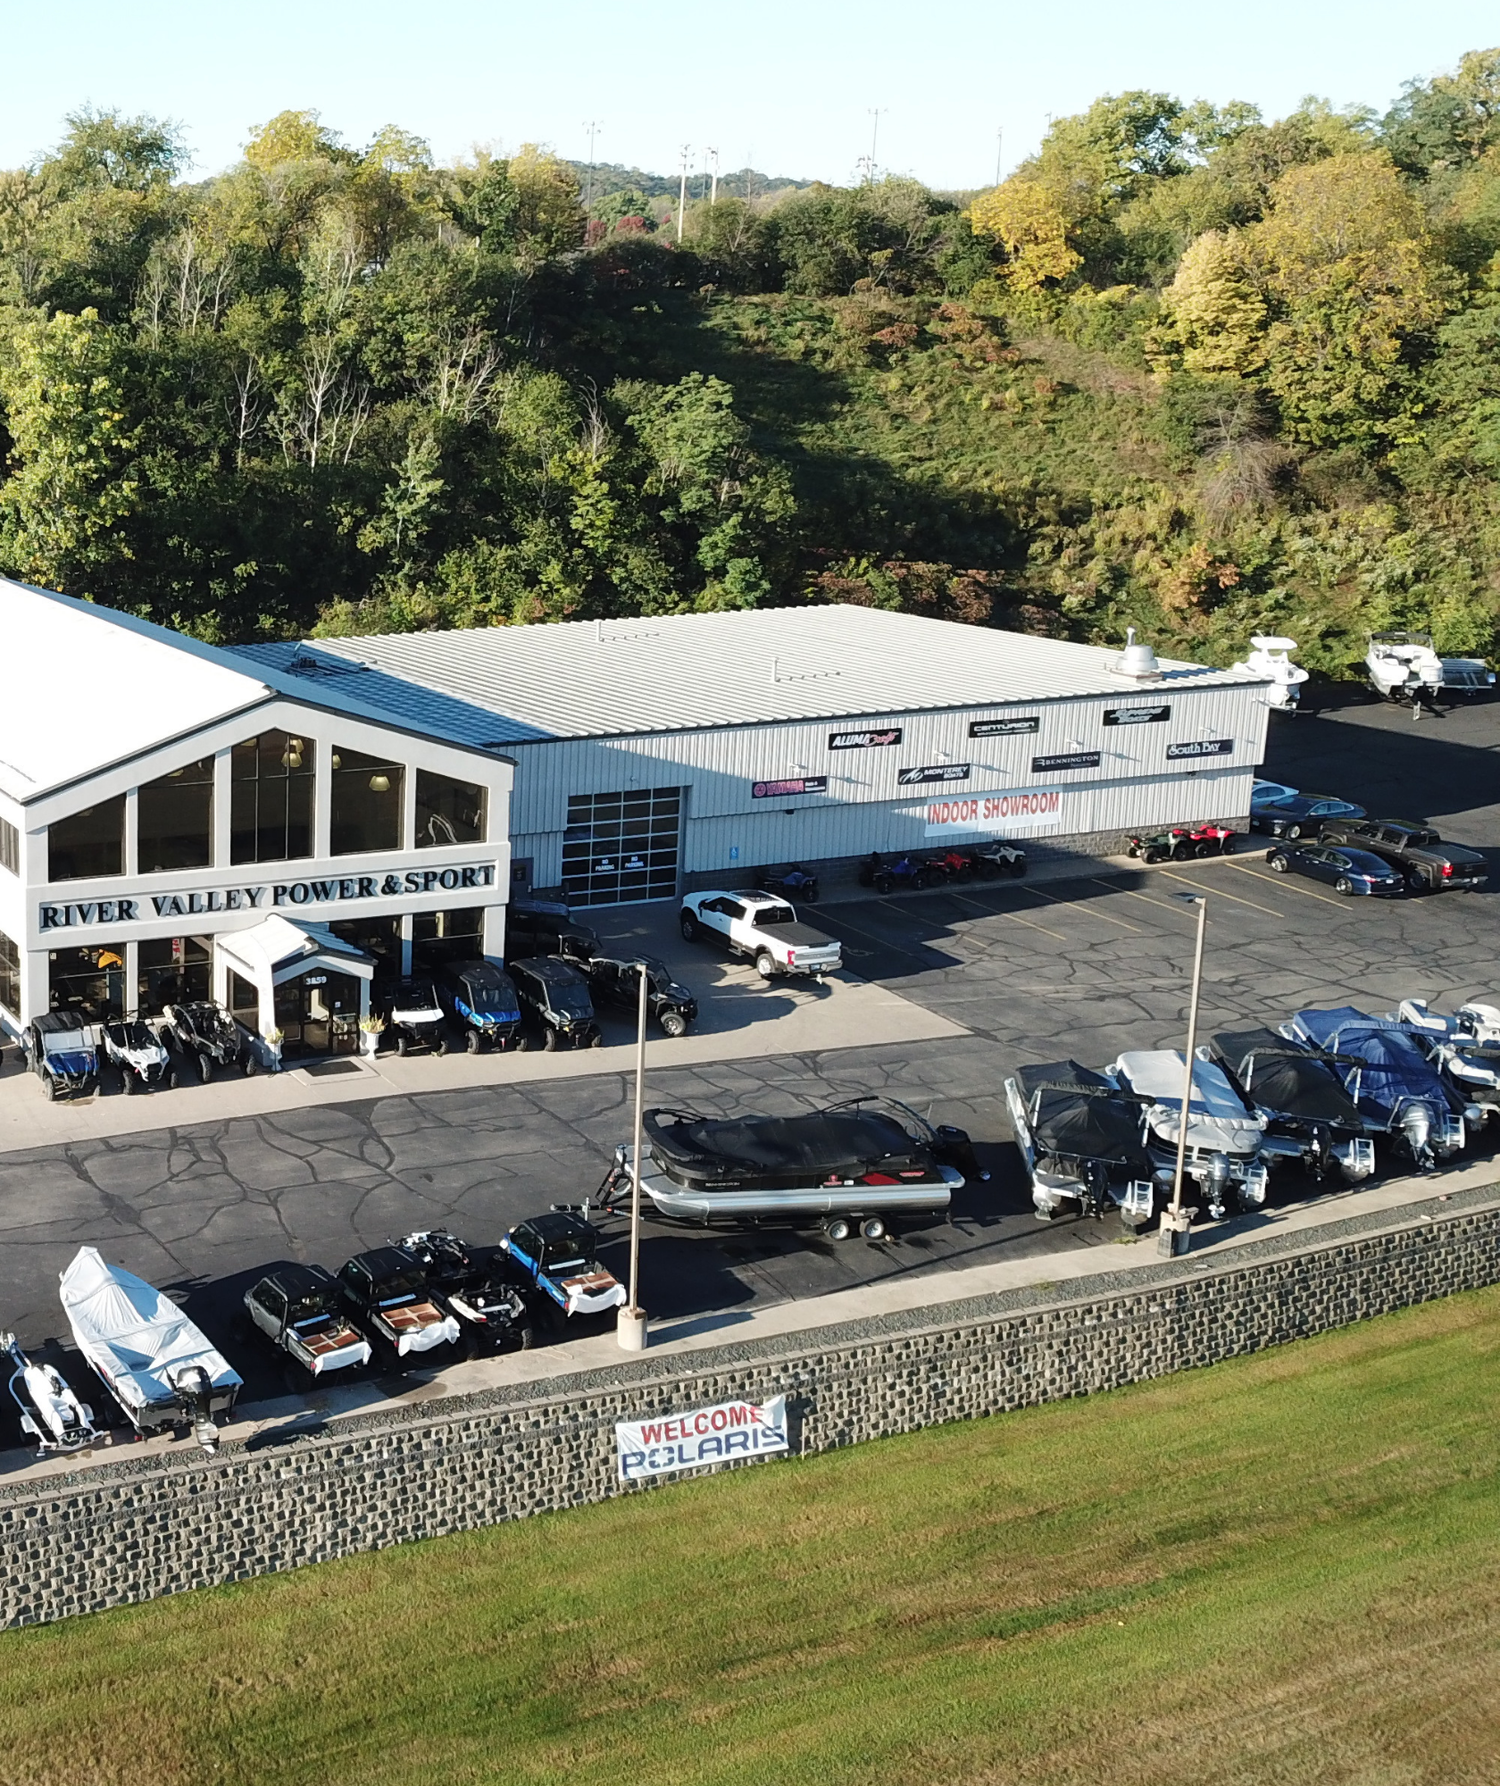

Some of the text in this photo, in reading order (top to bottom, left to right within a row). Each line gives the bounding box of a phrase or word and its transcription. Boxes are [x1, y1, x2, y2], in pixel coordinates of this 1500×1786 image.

[923, 765, 969, 776] MONTEREY
[1045, 755, 1099, 766] BENNINGTON
[766, 779, 805, 796] YAMAHA
[927, 791, 1060, 825] INDOOR SHOWROOM
[40, 864, 496, 929] RIVER VALLEY POWER & SPORT
[641, 1405, 765, 1446] WELCOME
[621, 1424, 788, 1479] POLARIS
